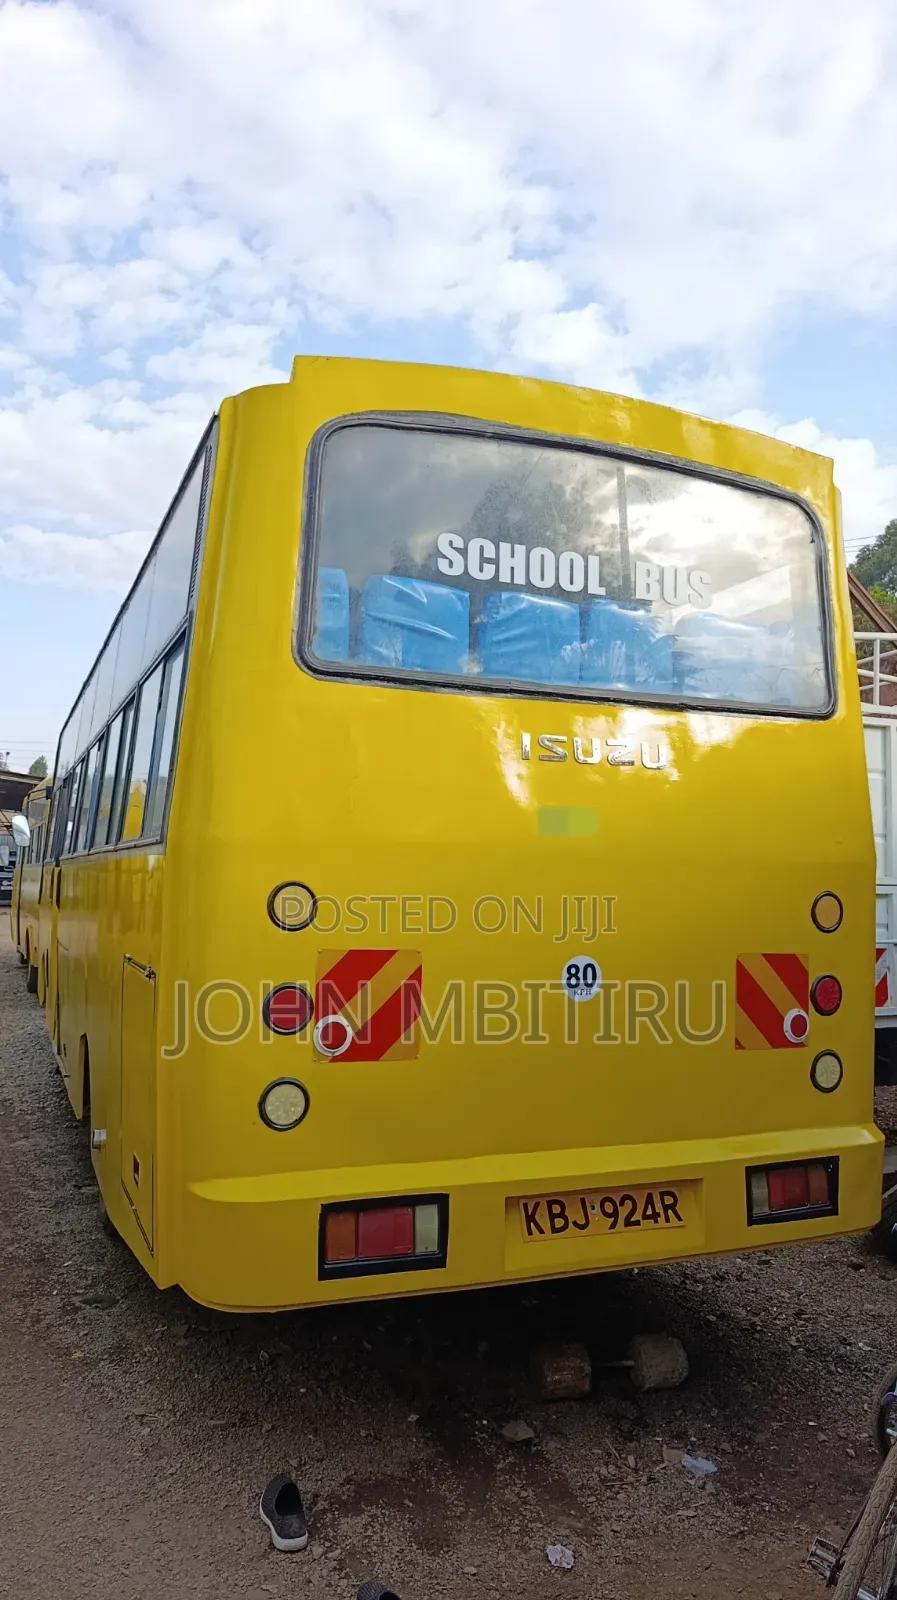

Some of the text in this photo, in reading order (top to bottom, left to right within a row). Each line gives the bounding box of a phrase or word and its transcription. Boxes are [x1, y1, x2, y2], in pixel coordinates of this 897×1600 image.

[437, 533, 712, 609] SCHOOL BUS
[520, 733, 669, 769] ISUZU
[566, 963, 597, 988] 80
[573, 988, 592, 996] KPH
[522, 1190, 683, 1236] KBJ 924R
